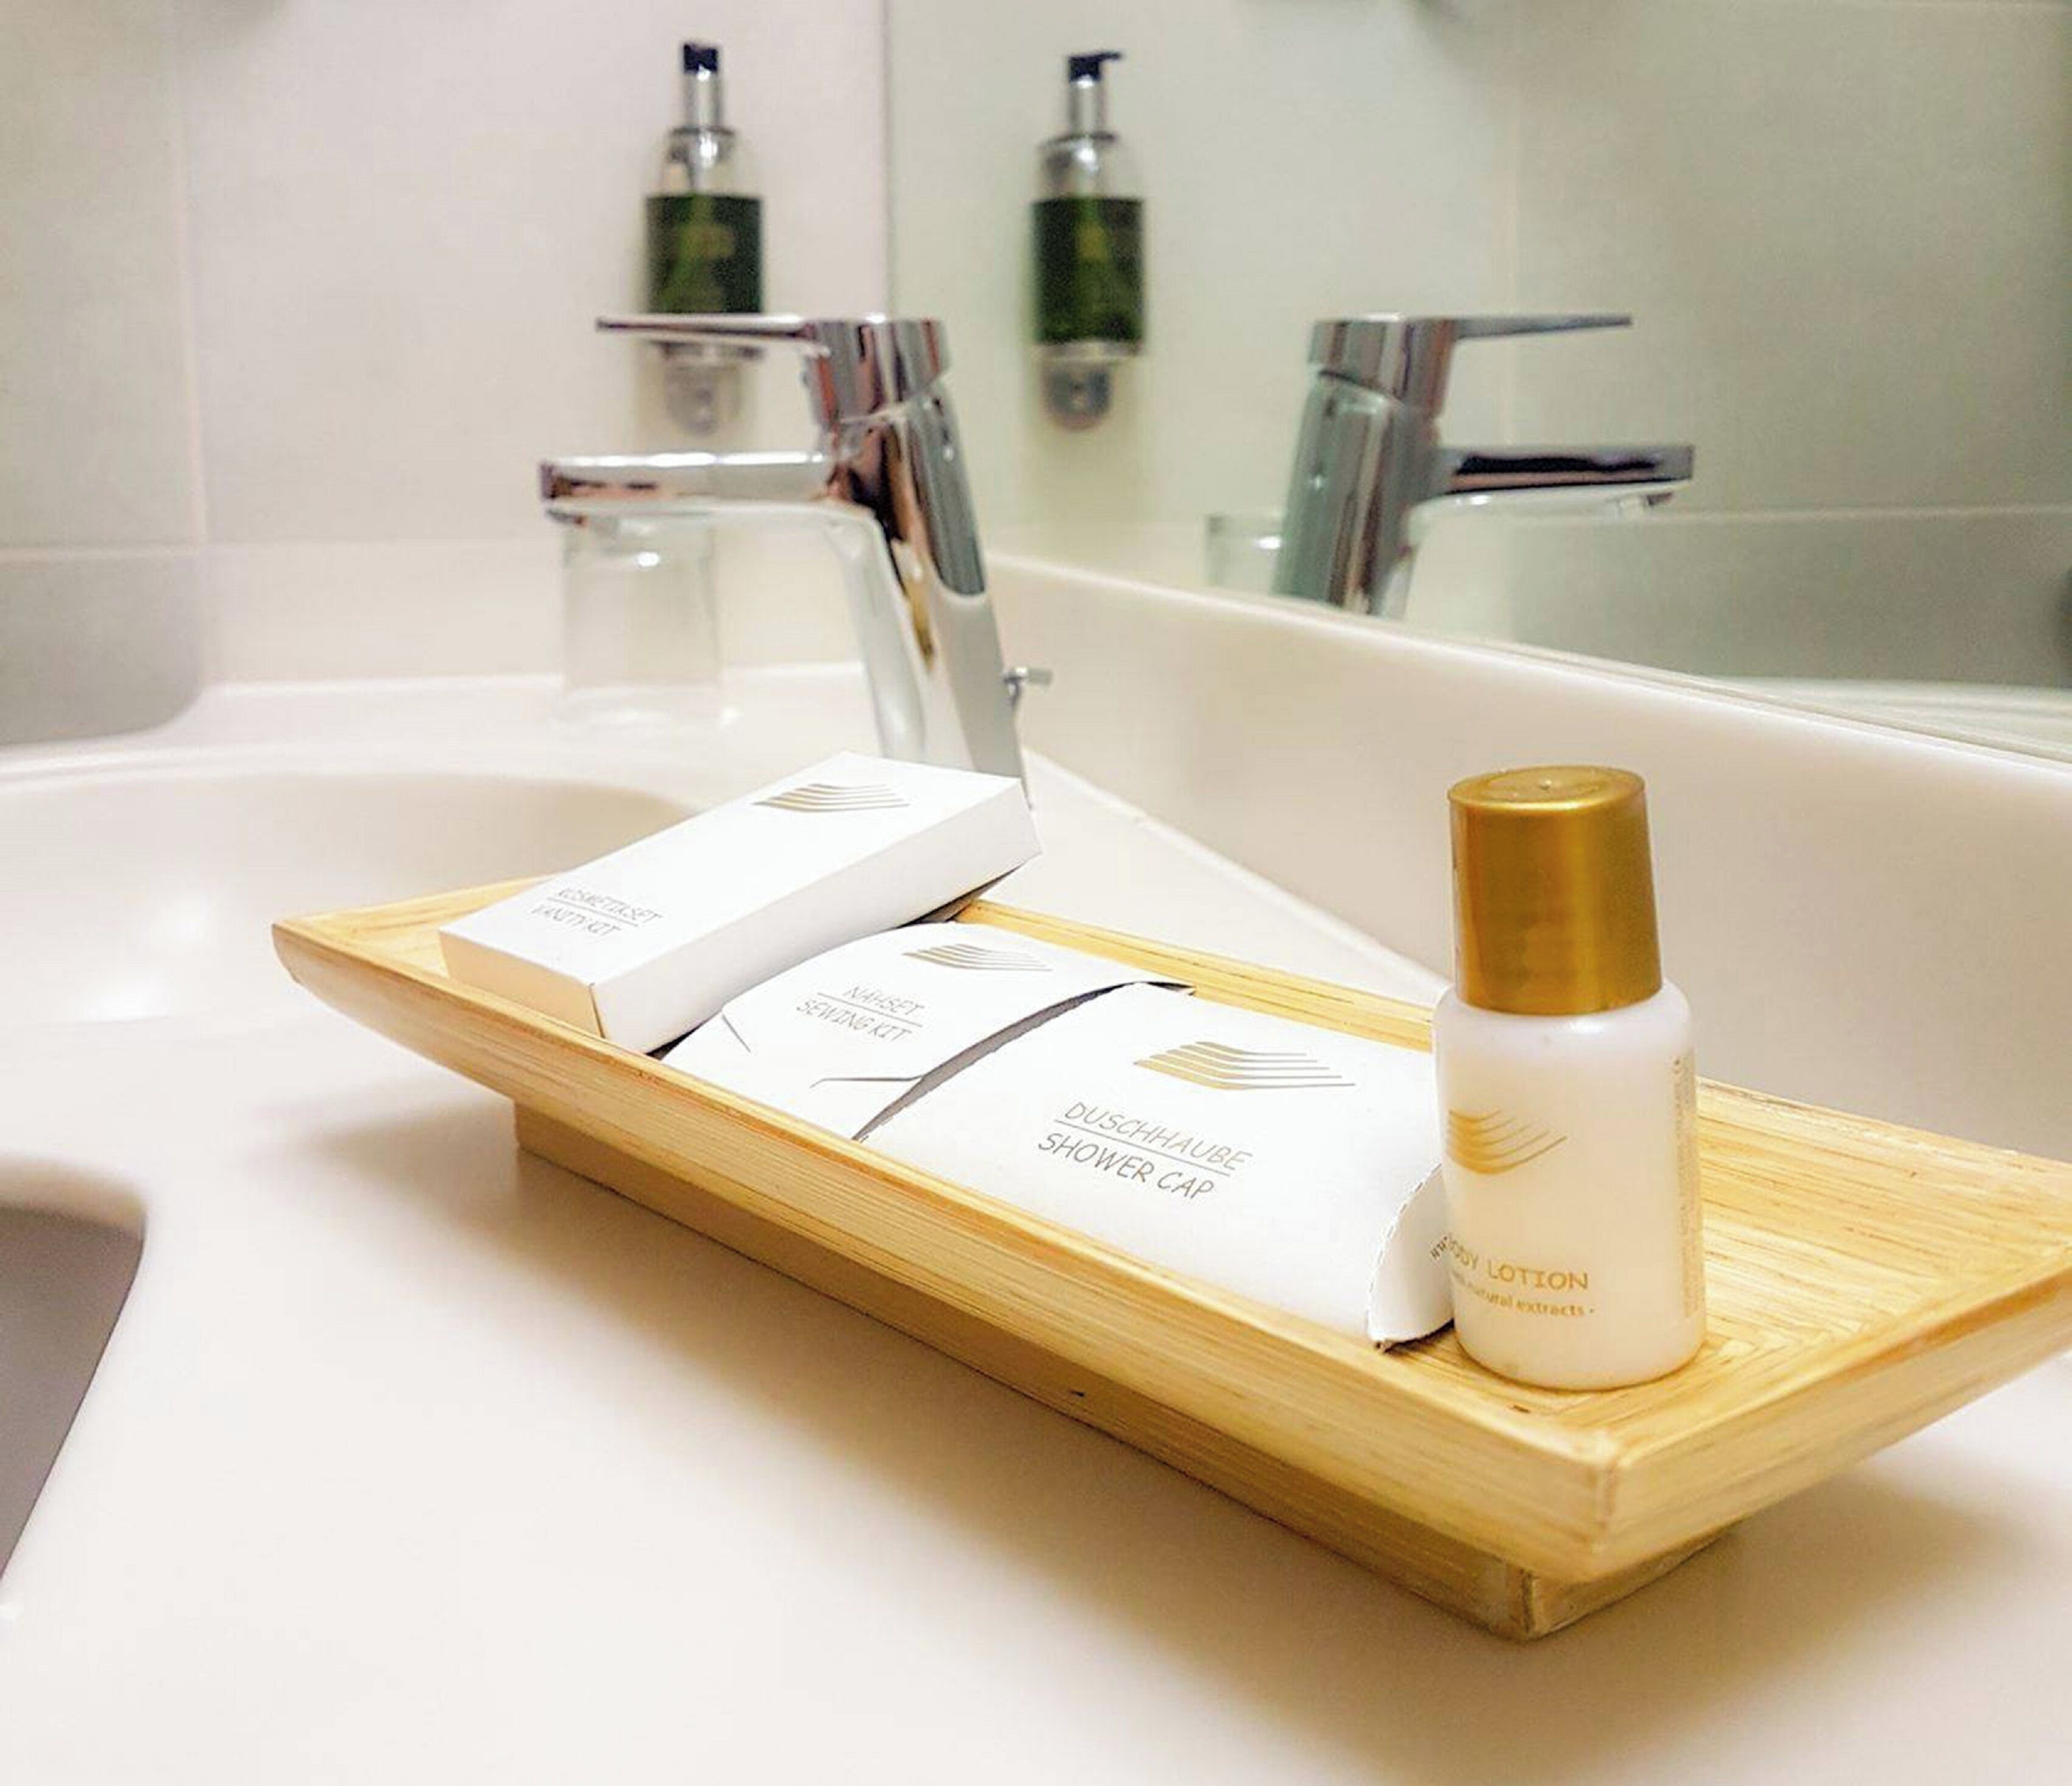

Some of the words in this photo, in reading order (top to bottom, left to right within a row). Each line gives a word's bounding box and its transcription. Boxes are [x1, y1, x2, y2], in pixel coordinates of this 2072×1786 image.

[582, 921, 622, 937] KIT
[796, 999, 875, 1031] SEWING
[868, 1022, 913, 1042] KIT
[1063, 1101, 1254, 1171] DUSCHHAUBE
[1037, 1132, 1155, 1184] SHOWER
[1157, 1172, 1215, 1200] CAP
[1487, 1259, 1589, 1290] LOTION
[1516, 1299, 1585, 1317] extracts
